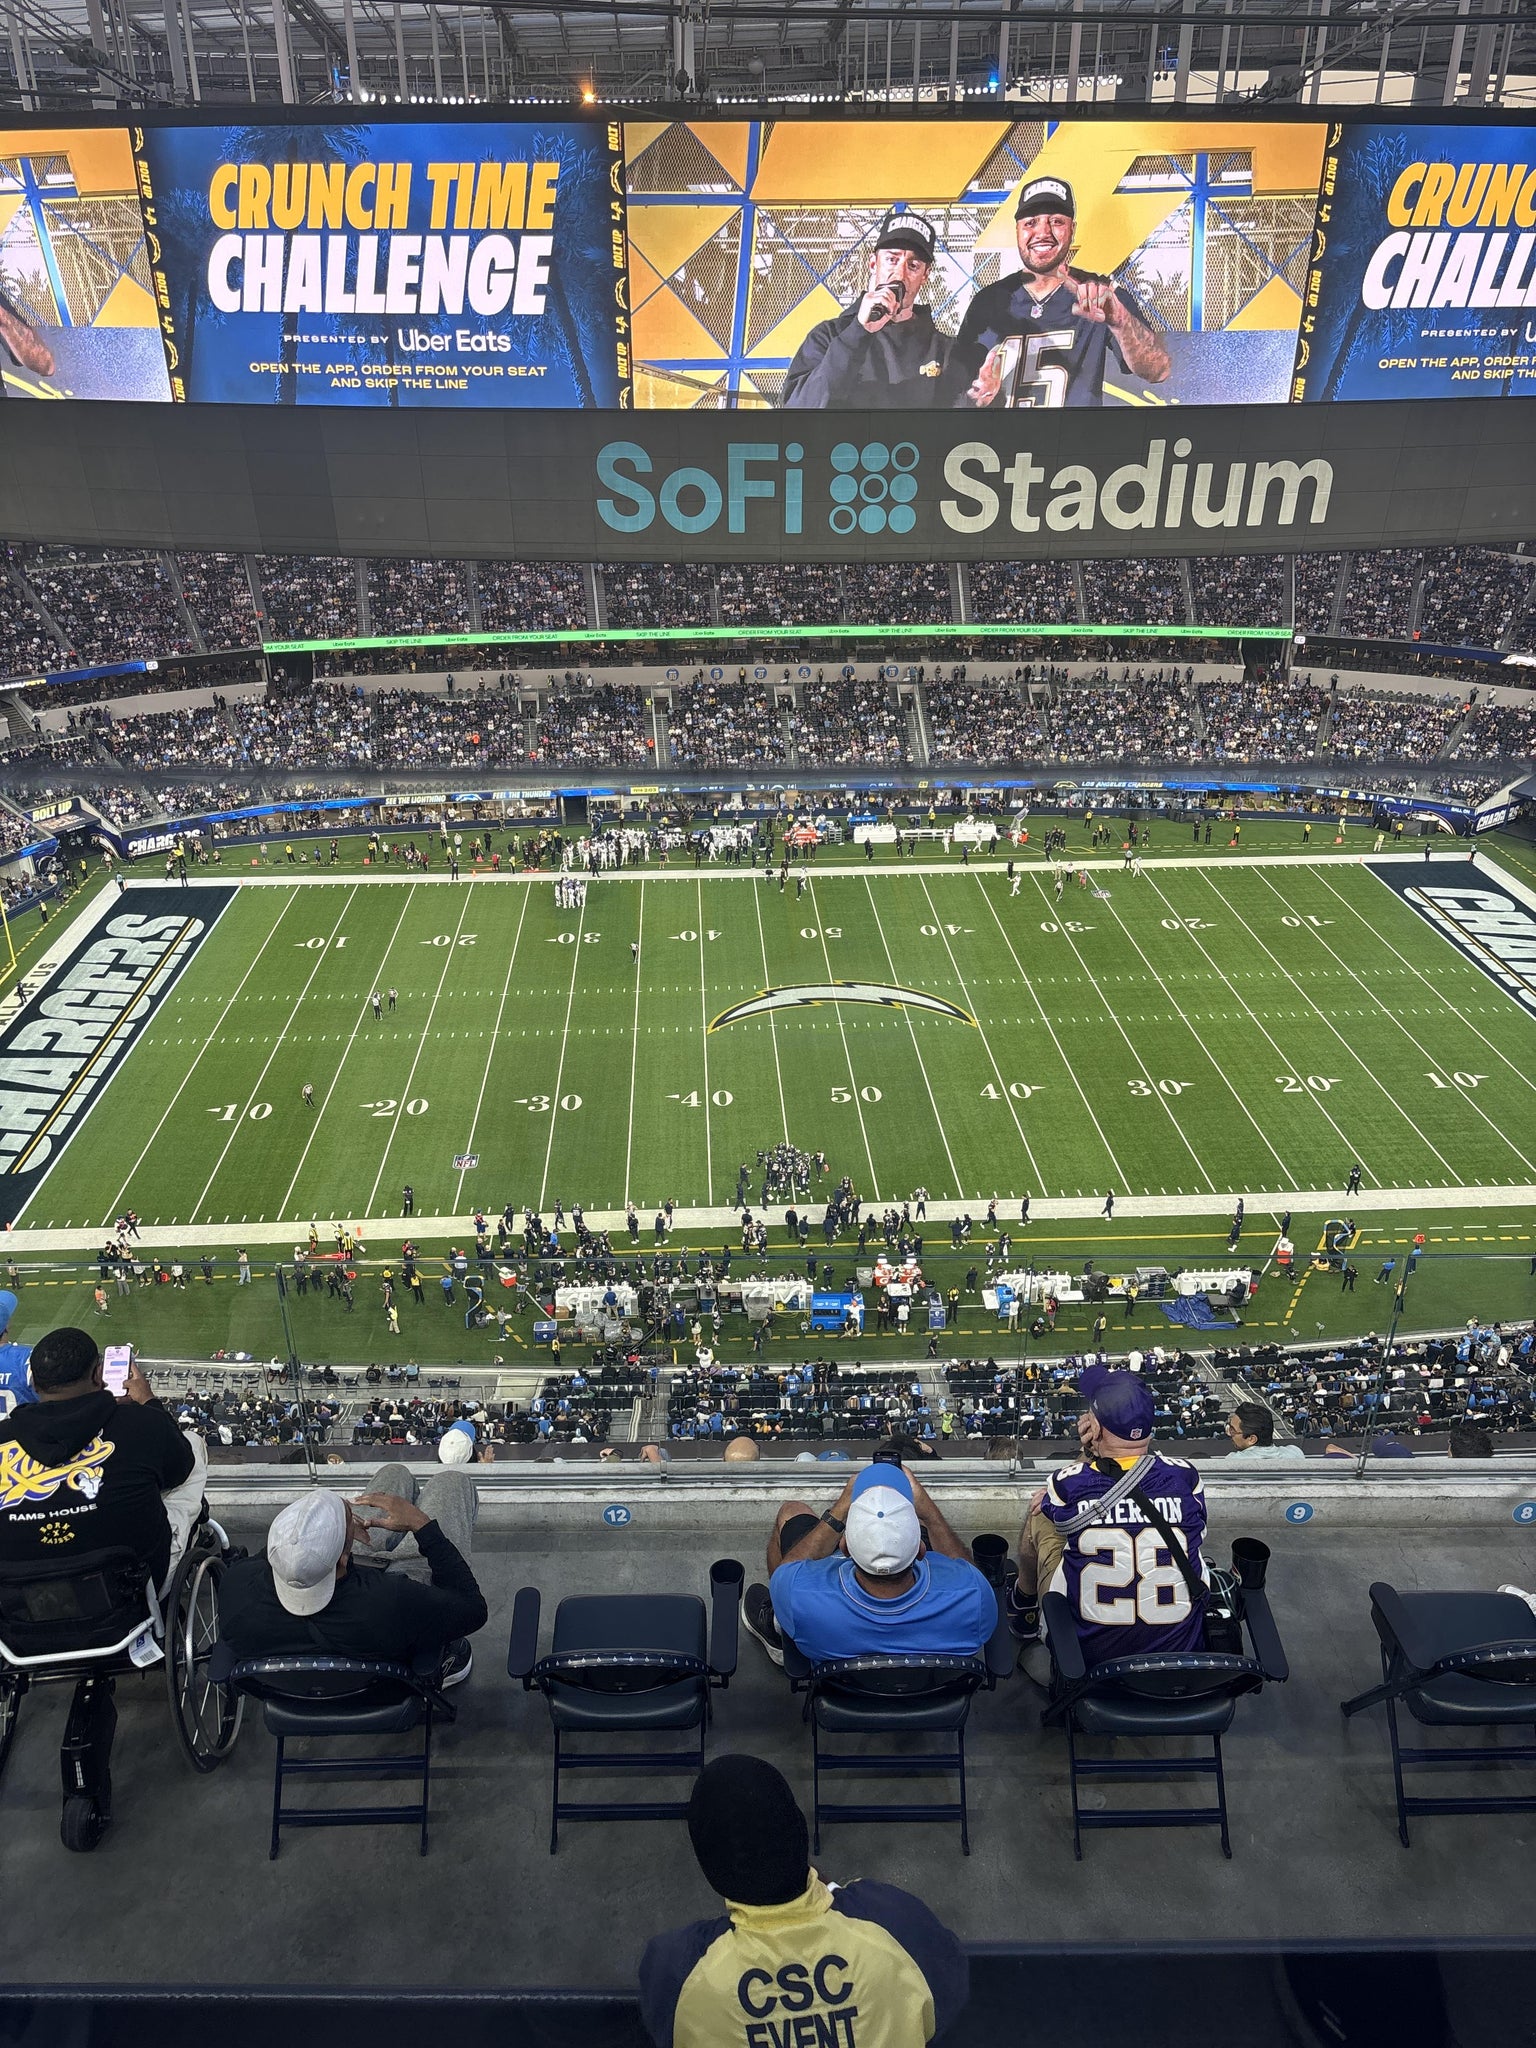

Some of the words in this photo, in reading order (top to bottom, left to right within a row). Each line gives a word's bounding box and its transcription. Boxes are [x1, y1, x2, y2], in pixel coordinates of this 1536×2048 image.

[139, 160, 151, 182] BOLT
[1327, 156, 1338, 179] BOLT
[142, 183, 153, 199] UP
[209, 162, 412, 230] CRUNCH
[427, 162, 560, 230] TIME
[1324, 180, 1335, 196] UP
[613, 229, 624, 244] UP
[613, 246, 624, 269] BOLT
[207, 233, 554, 316] CHALLENGE
[1361, 231, 1536, 310] CHALL
[154, 271, 169, 293] BOLT
[1311, 270, 1323, 292] BOLT
[160, 294, 171, 309] UP
[1308, 293, 1318, 308] UP
[283, 335, 367, 345] PRESENTED
[369, 336, 389, 345] BY
[398, 328, 452, 353] Uber
[456, 330, 512, 353] Eats
[1420, 329, 1498, 338] PRESENTED
[1501, 328, 1518, 337] BY
[618, 342, 628, 356] UP
[249, 363, 290, 374] OPEN
[292, 363, 322, 375] THE
[325, 364, 358, 377] APP,
[361, 364, 413, 376] ORDER
[415, 365, 458, 377] FROM
[461, 365, 506, 378] YOUR
[507, 366, 548, 378] SEAT
[617, 358, 628, 379] BOLT
[996, 329, 1076, 409] 15
[1378, 358, 1417, 369] OPEN
[1420, 358, 1448, 368] THE
[1450, 357, 1481, 368] APP,
[1484, 356, 1529, 367] ORDER
[330, 377, 362, 388] AND
[365, 378, 399, 389] SKIP
[401, 378, 433, 390] THE
[436, 378, 469, 390] LINE
[1451, 370, 1481, 380] AND
[1483, 369, 1514, 380] SKIP
[596, 441, 805, 535] SoFi
[939, 437, 1335, 534] Stadium
[385, 797, 397, 805] SEE
[398, 796, 410, 804] THE
[411, 794, 447, 804] LIGHTNING
[492, 791, 507, 799] FEEL
[509, 791, 521, 799] THE
[522, 790, 552, 798] THUNDER
[32, 804, 56, 822] BOLT
[58, 800, 72, 815] UP
[800, 927, 844, 939] 50
[30, 963, 58, 977] US
[1127, 1079, 1182, 1096] 30
[1274, 1075, 1331, 1093] 20
[1422, 1070, 1479, 1089] 10
[681, 1090, 734, 1108] 40
[831, 1085, 883, 1103] 50
[979, 1082, 1033, 1100] 40
[216, 1102, 273, 1121] 10
[371, 1098, 429, 1117] 20
[527, 1094, 583, 1112] 30
[9, 1512, 46, 1522] RAMS
[49, 1503, 98, 1518] HOUSE
[607, 1509, 628, 1523] 12
[1293, 1507, 1306, 1520] 9
[1520, 1506, 1534, 1519] 8
[40, 1521, 70, 1533] BORN
[41, 1532, 75, 1544] RAISED
[1078, 1527, 1193, 1626] 28
[737, 1954, 854, 2019] CSC
